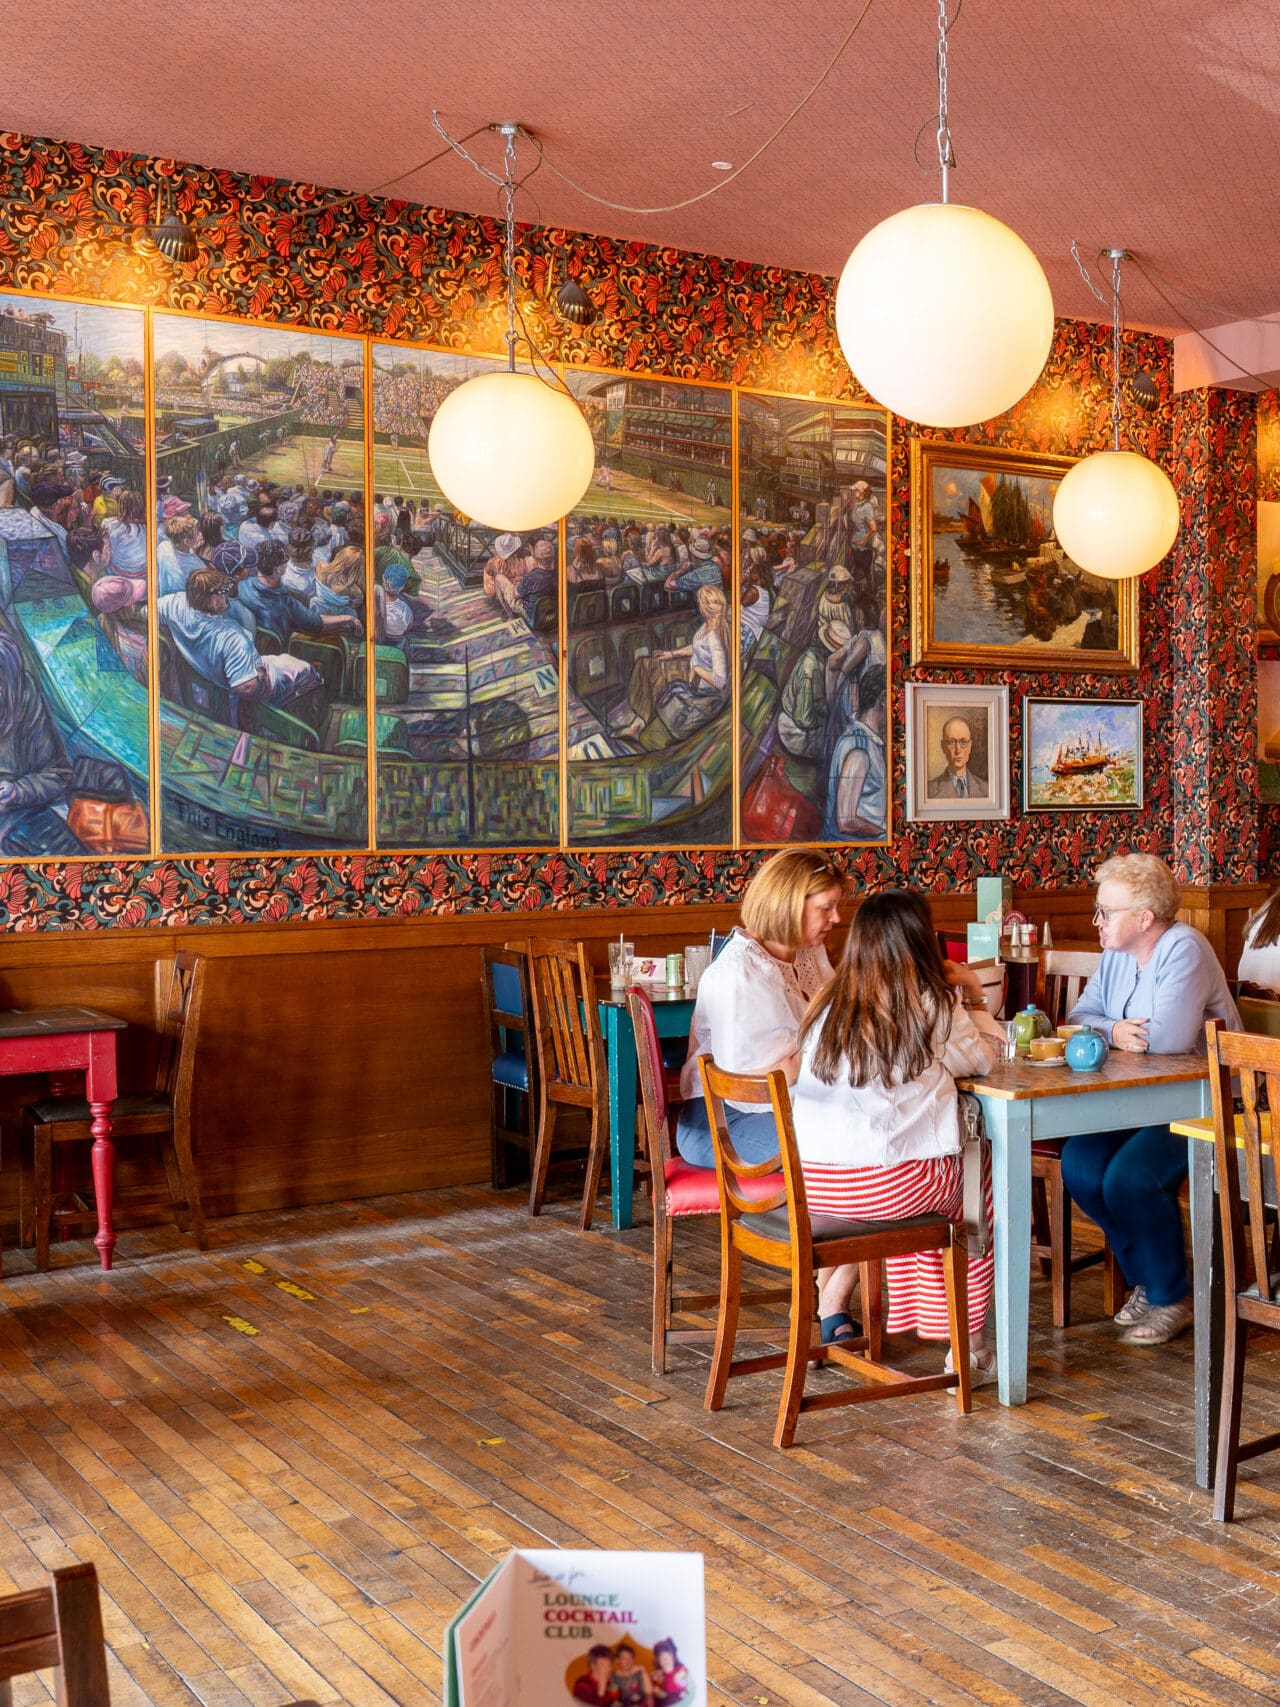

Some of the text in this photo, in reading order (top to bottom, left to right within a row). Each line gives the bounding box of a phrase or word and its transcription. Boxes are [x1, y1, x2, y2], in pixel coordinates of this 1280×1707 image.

[536, 668, 557, 690] N
[215, 815, 280, 848] England
[543, 1592, 620, 1607] LOUNGE
[543, 1608, 639, 1624] COCKTAIL
[543, 1624, 593, 1639] CLUB
